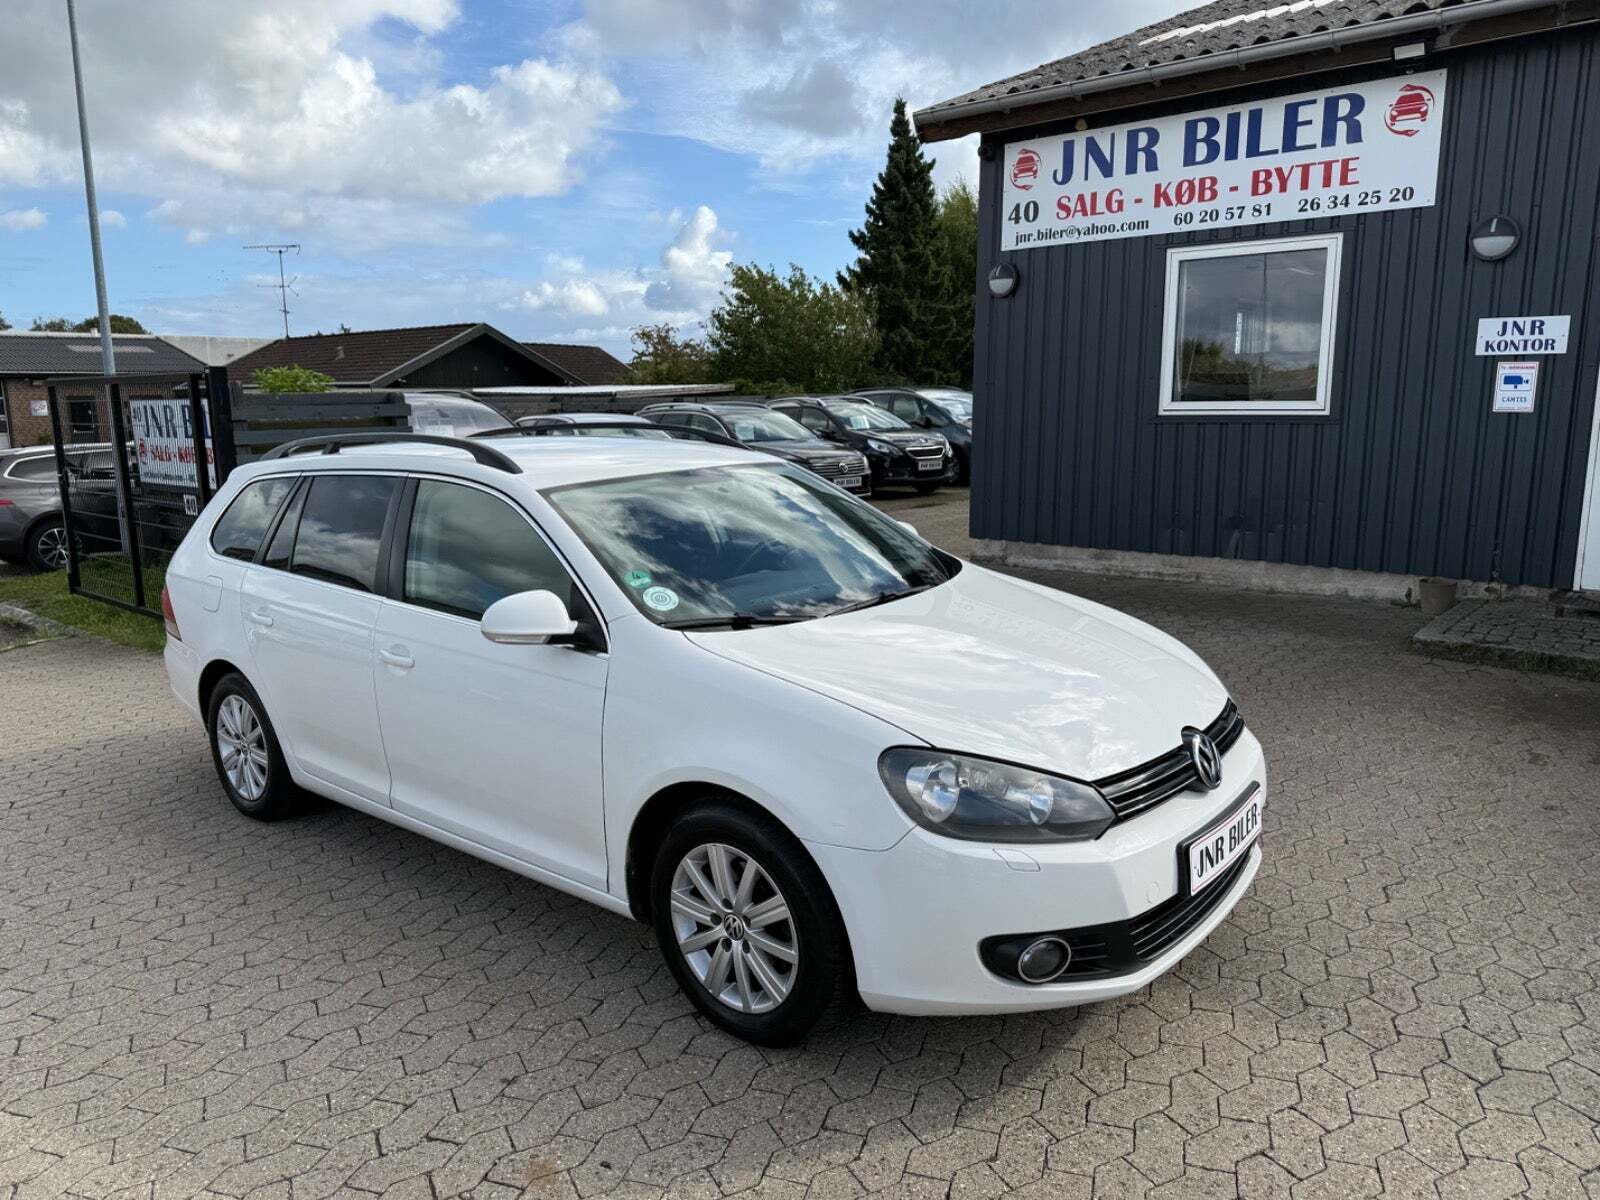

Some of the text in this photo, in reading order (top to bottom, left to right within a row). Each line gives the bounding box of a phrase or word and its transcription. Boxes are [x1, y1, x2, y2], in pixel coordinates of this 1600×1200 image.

[1053, 92, 1366, 185] JNR BILER
[1008, 200, 1039, 225] 40
[1015, 186, 1415, 246] jnr.biler@yahoo.com 60 20 57 81 26 34 25 20
[1056, 188, 1124, 220] SALG
[1154, 175, 1219, 208] KØB
[1251, 157, 1360, 197] BYTTE
[1484, 338, 1556, 353] KONTOR
[1497, 319, 1546, 337] JNR
[1198, 803, 1257, 878] JNR BILER
